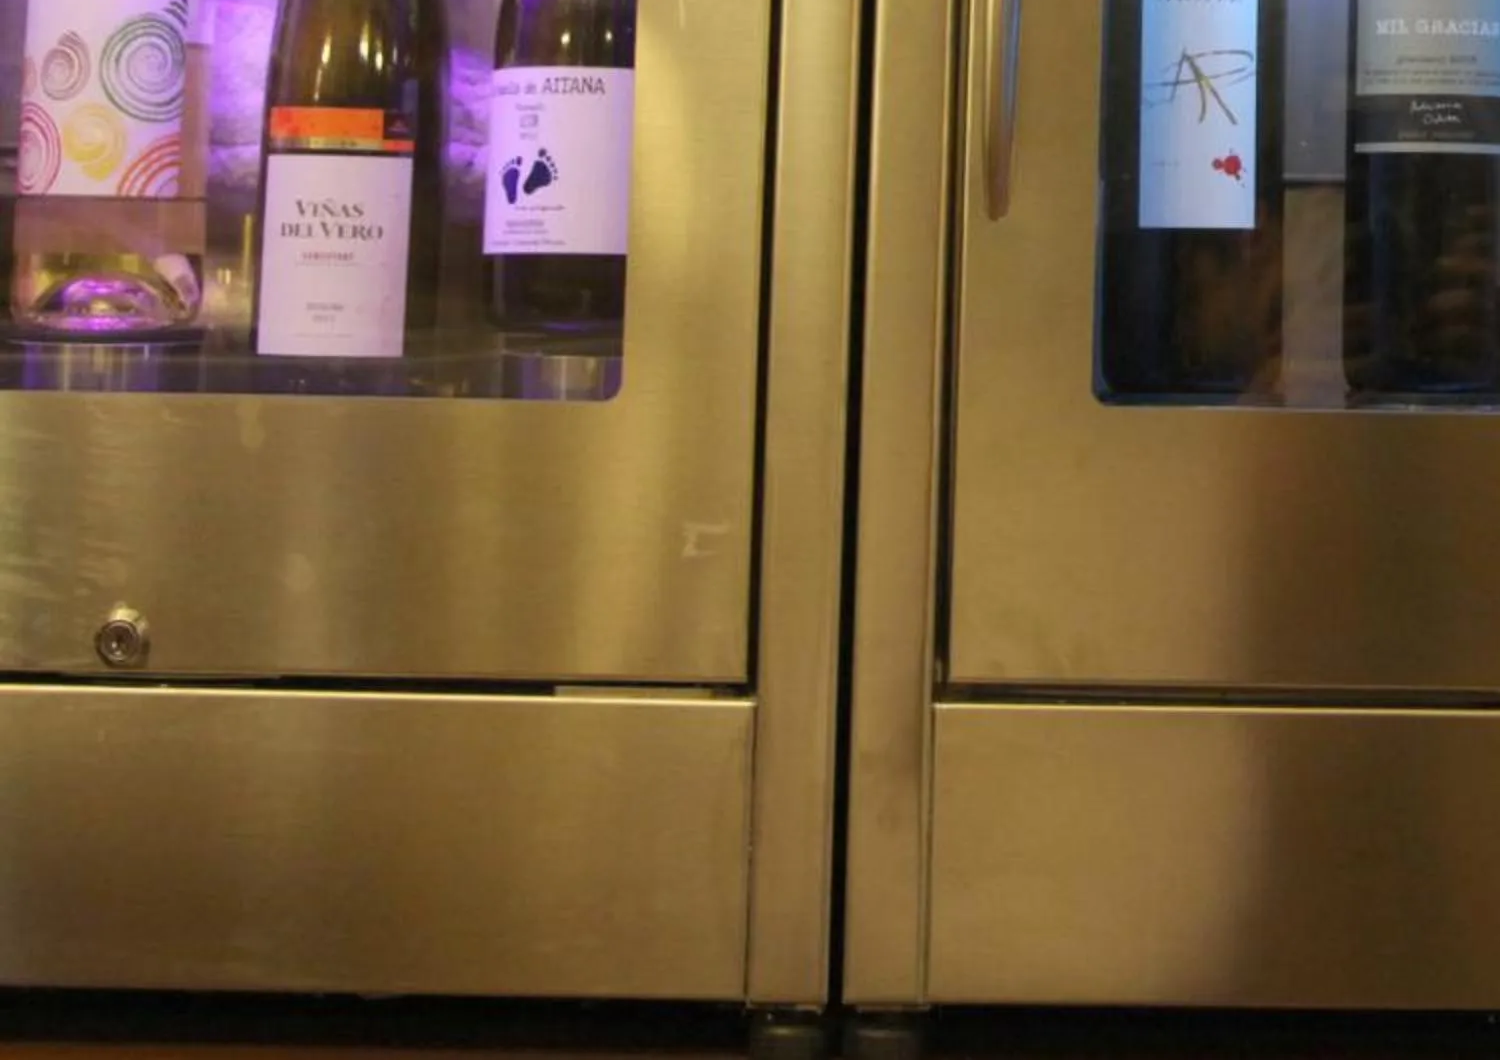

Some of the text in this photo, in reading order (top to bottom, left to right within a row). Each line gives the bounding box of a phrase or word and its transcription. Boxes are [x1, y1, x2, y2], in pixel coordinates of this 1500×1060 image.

[1375, 19, 1500, 37] MIL GRACIAS
[542, 76, 606, 96] AITANA
[295, 198, 365, 219] VIÑAS
[320, 221, 385, 241] VERO
